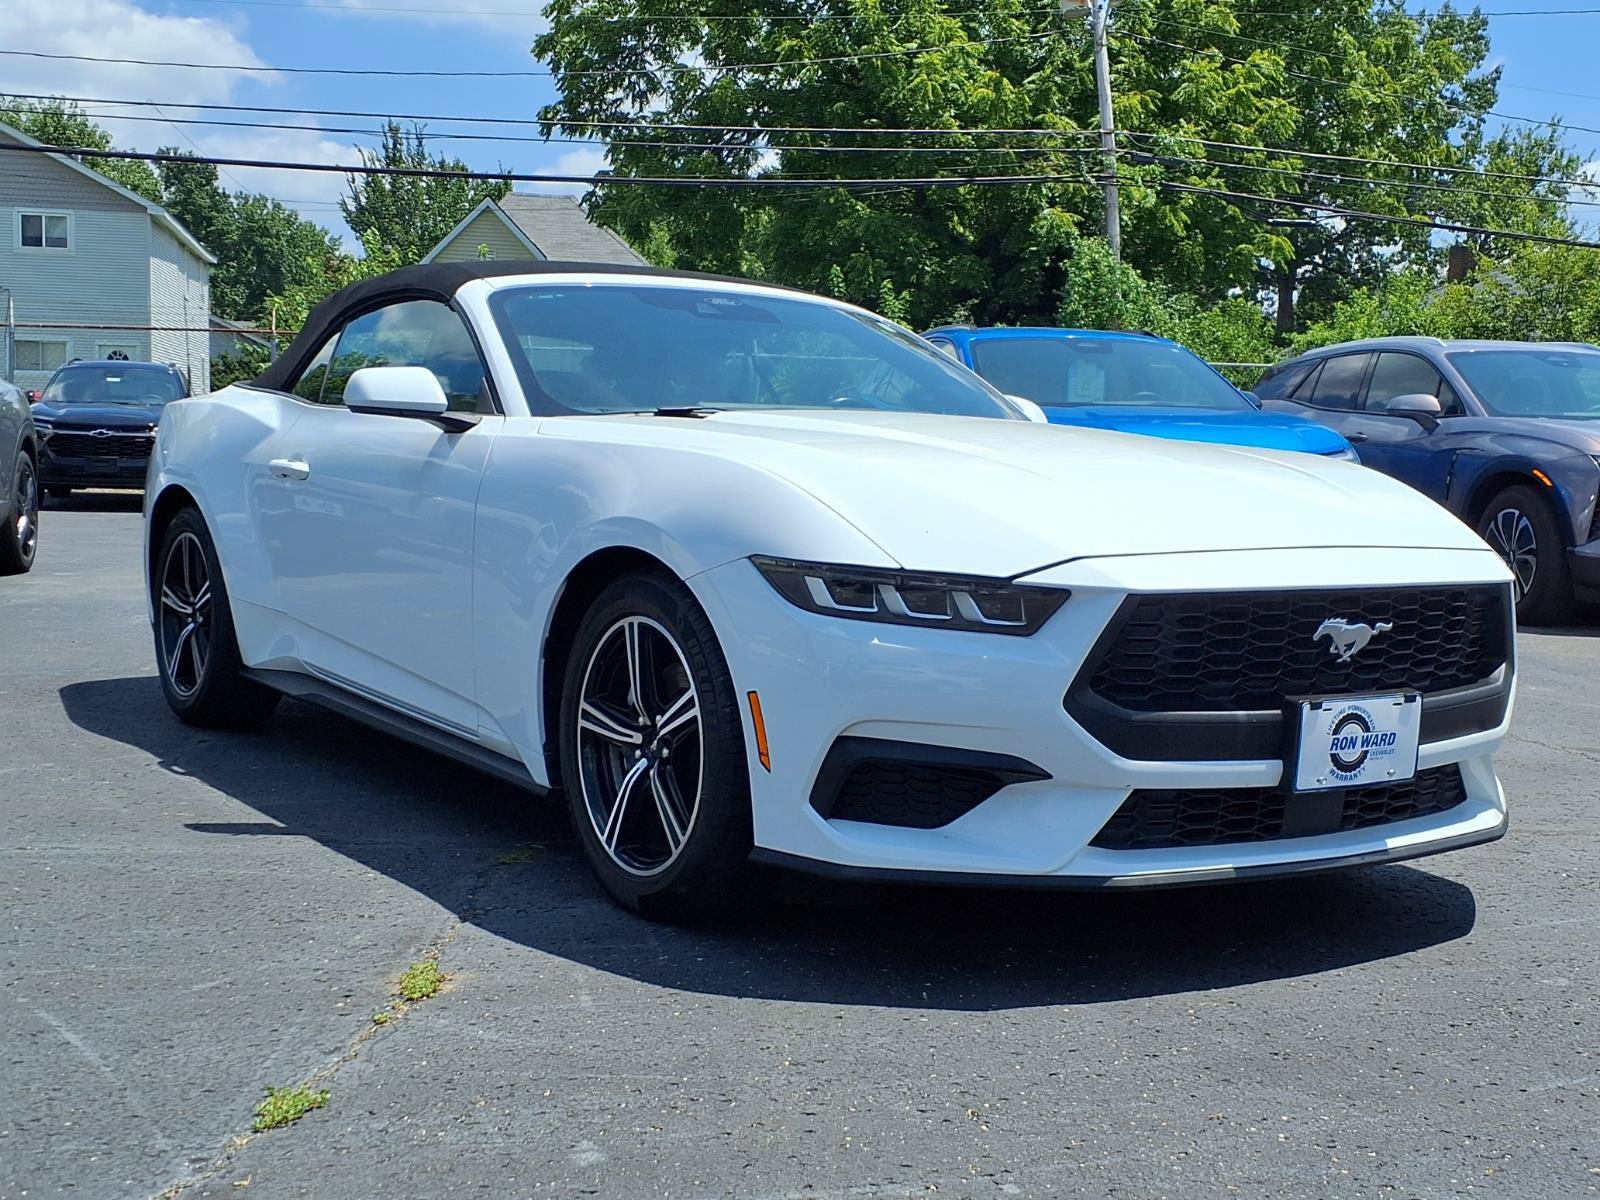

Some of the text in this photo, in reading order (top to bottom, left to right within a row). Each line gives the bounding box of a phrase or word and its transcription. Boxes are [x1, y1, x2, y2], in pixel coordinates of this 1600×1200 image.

[1326, 704, 1376, 735] LIFETIME POWERTRAIN
[1329, 732, 1397, 751] RON WARD
[1369, 748, 1395, 757] CHEVROLET
[1329, 765, 1366, 782] WARRANTY
